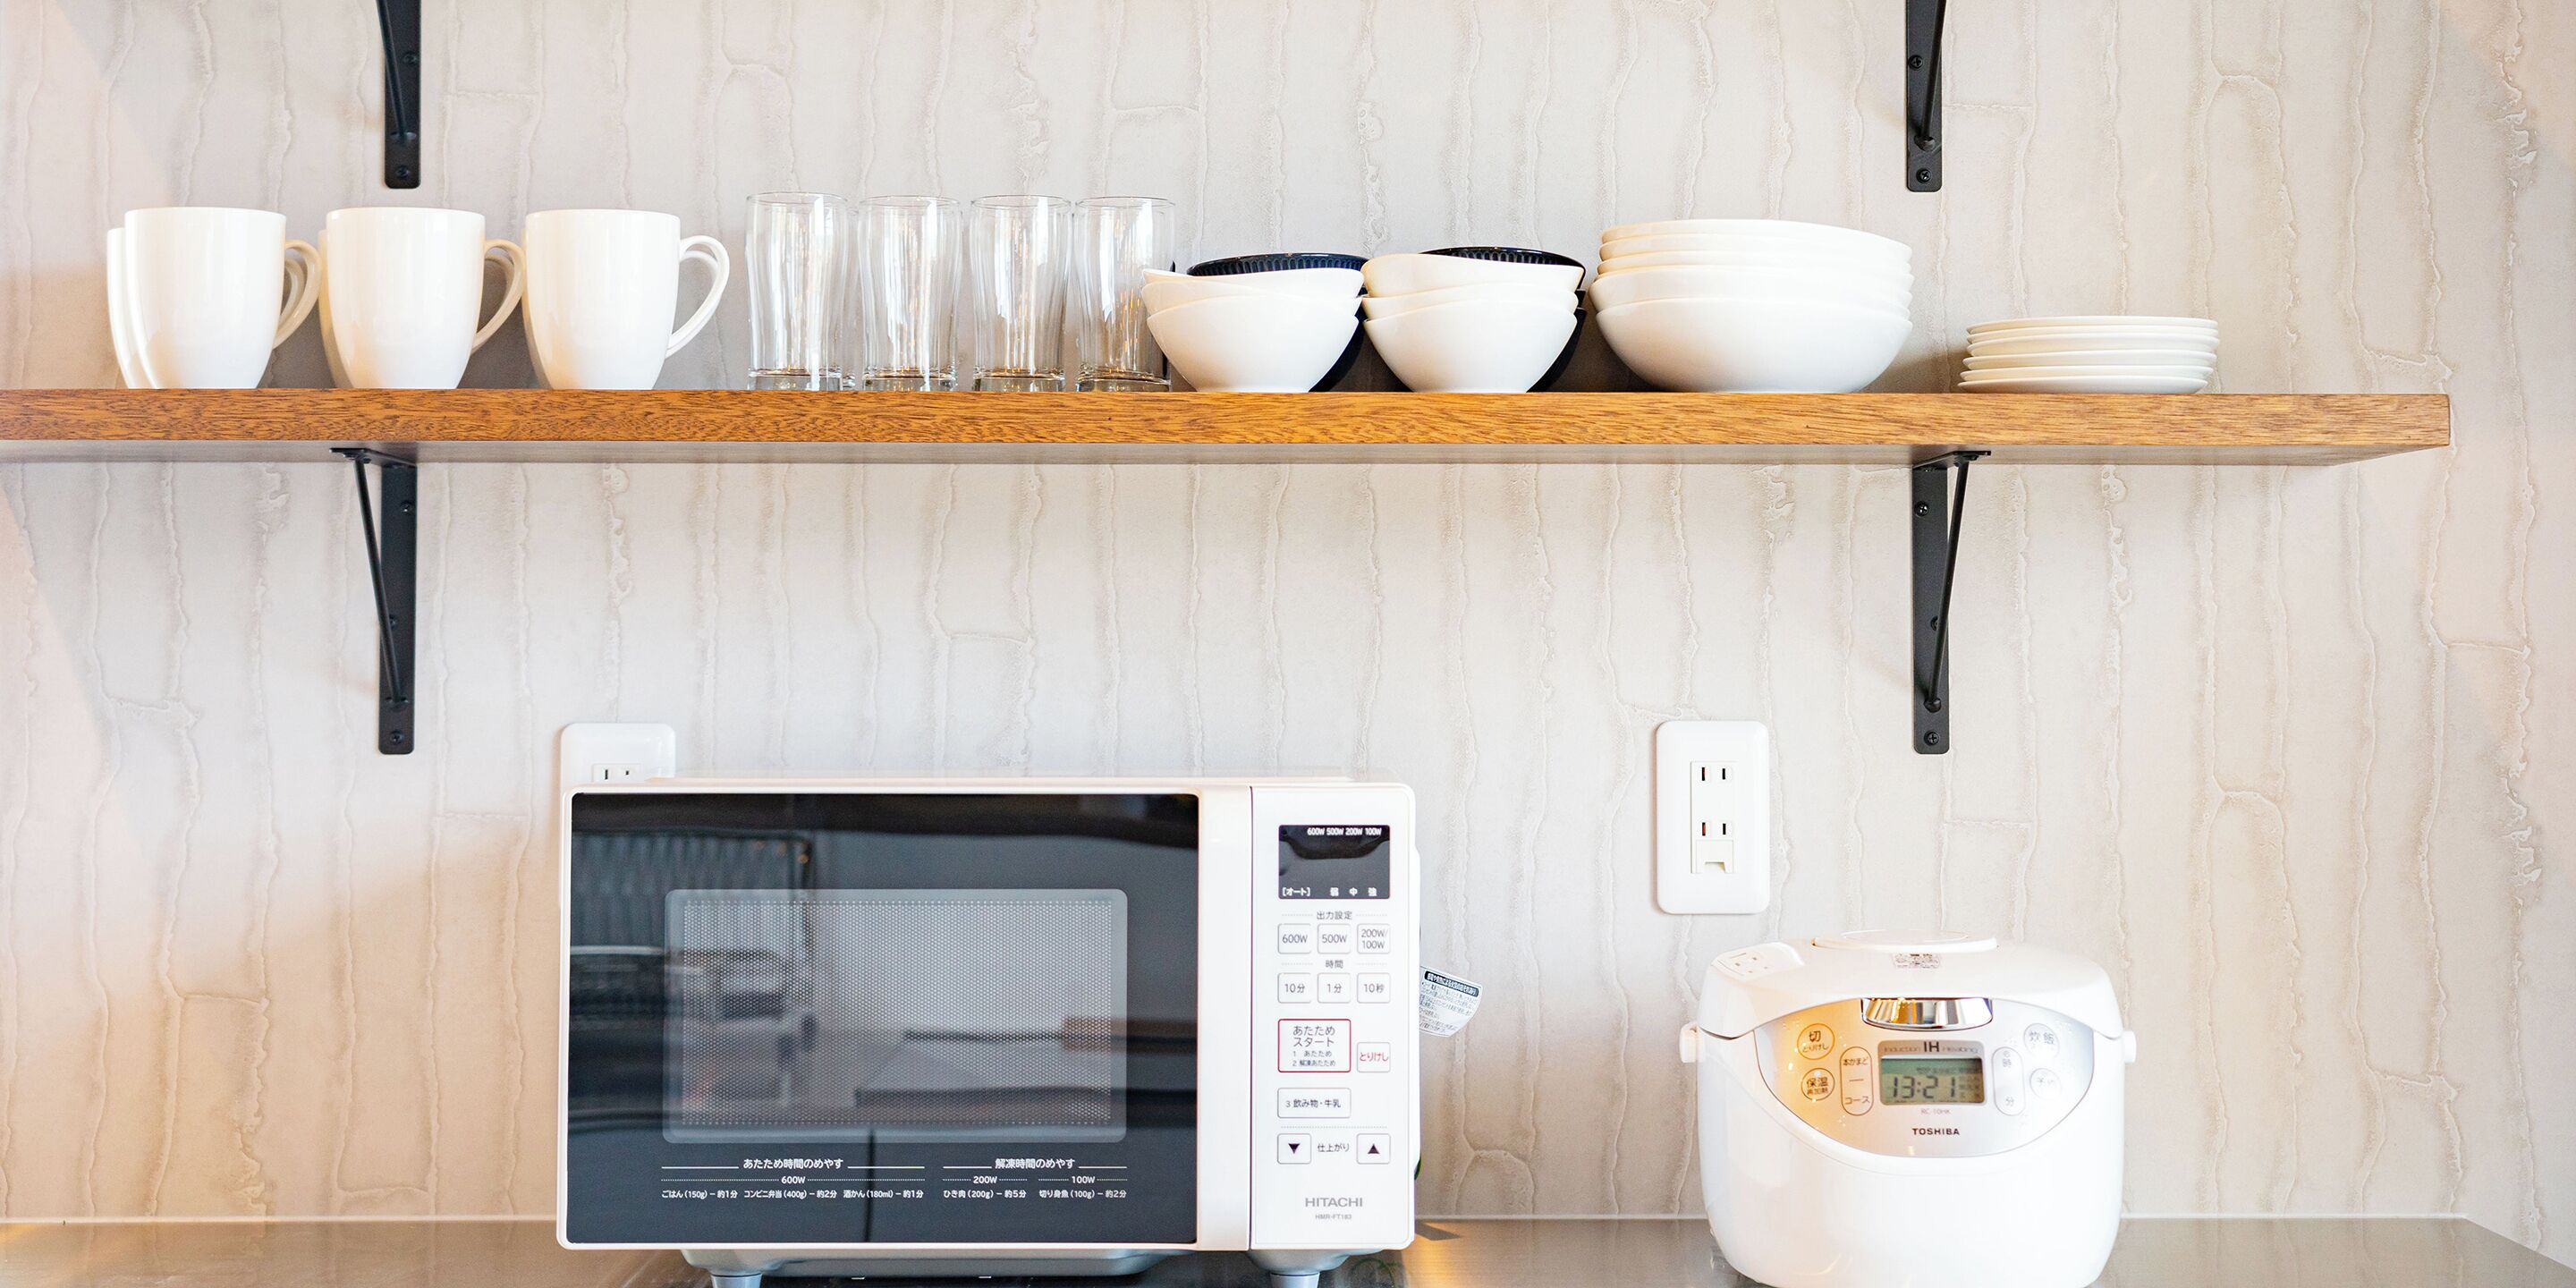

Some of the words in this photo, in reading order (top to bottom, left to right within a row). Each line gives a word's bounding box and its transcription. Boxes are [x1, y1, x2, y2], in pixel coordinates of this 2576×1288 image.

[1307, 827, 1325, 835] 600W
[1326, 827, 1344, 835] 500W
[1345, 827, 1363, 835] 200W
[1365, 827, 1382, 835] 100W
[1316, 911, 1352, 919] 出力設定
[1361, 928, 1387, 938] 200W/
[1282, 934, 1308, 943] 600W
[1322, 934, 1347, 943] 500W
[1362, 940, 1385, 950] 100W
[1325, 960, 1343, 969] 時間
[1284, 983, 1305, 994] 10分
[1364, 983, 1385, 993] 10秒
[1292, 1026, 1335, 1037] あたため
[1809, 1030, 1821, 1043] 切
[1292, 1037, 1335, 1047] スタート
[1924, 1041, 1939, 1052] IH
[1359, 1052, 1389, 1062] とりけし
[1893, 1075, 1956, 1098] 13:21
[1285, 1100, 1291, 1108] 3
[1845, 1095, 1870, 1105] コース
[1912, 1127, 1961, 1136] TOSHIBA
[1317, 1143, 1350, 1153] 仕上がり
[742, 1158, 843, 1170] あたため時間のめやす
[995, 1158, 1075, 1170] 解凍時間のめやす
[781, 1175, 806, 1184] 600W
[973, 1175, 997, 1184] 200W
[1072, 1175, 1096, 1184] 100W
[1305, 1197, 1363, 1208] HITACHI
